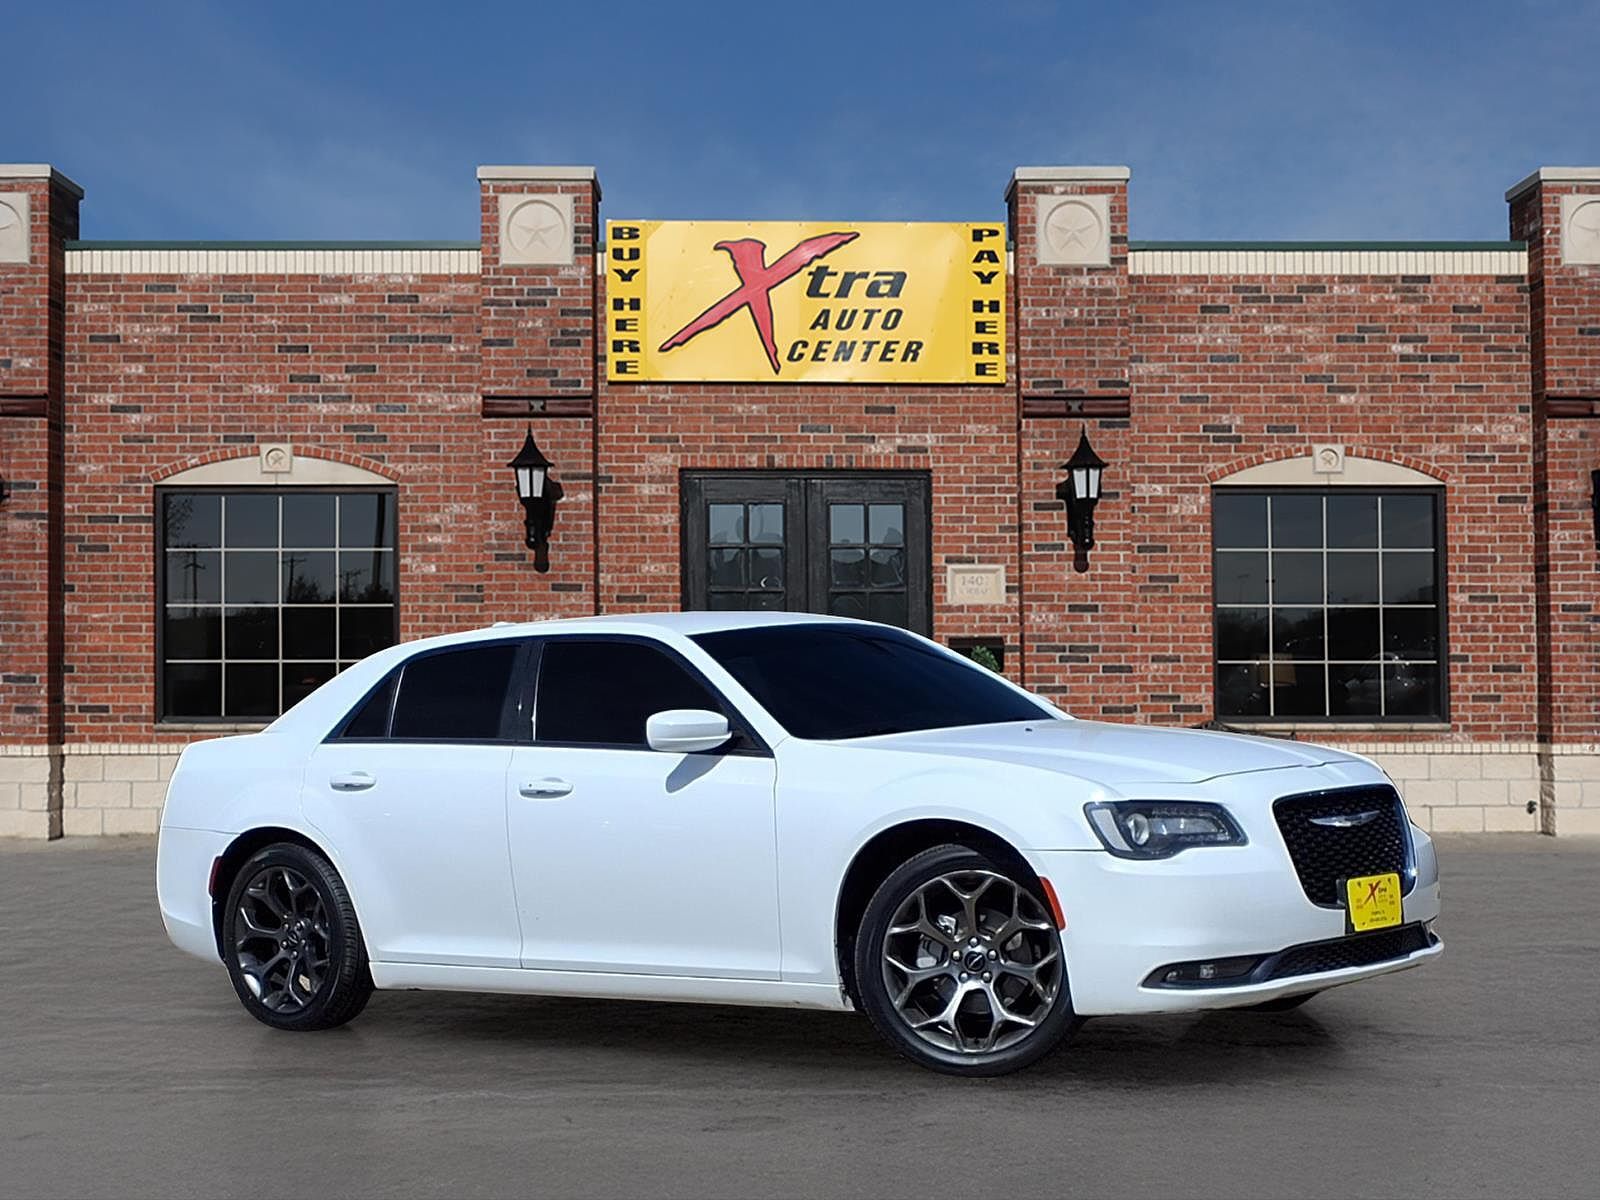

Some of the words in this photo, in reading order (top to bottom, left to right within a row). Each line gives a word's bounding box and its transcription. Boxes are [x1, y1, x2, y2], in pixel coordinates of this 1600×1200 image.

[612, 226, 641, 282] BUY
[972, 228, 1001, 285] PAY
[658, 231, 907, 375] Xtra
[809, 308, 903, 331] AUTO
[612, 297, 641, 375] HERE
[786, 340, 924, 362] CENTER
[972, 299, 1001, 377] HERE
